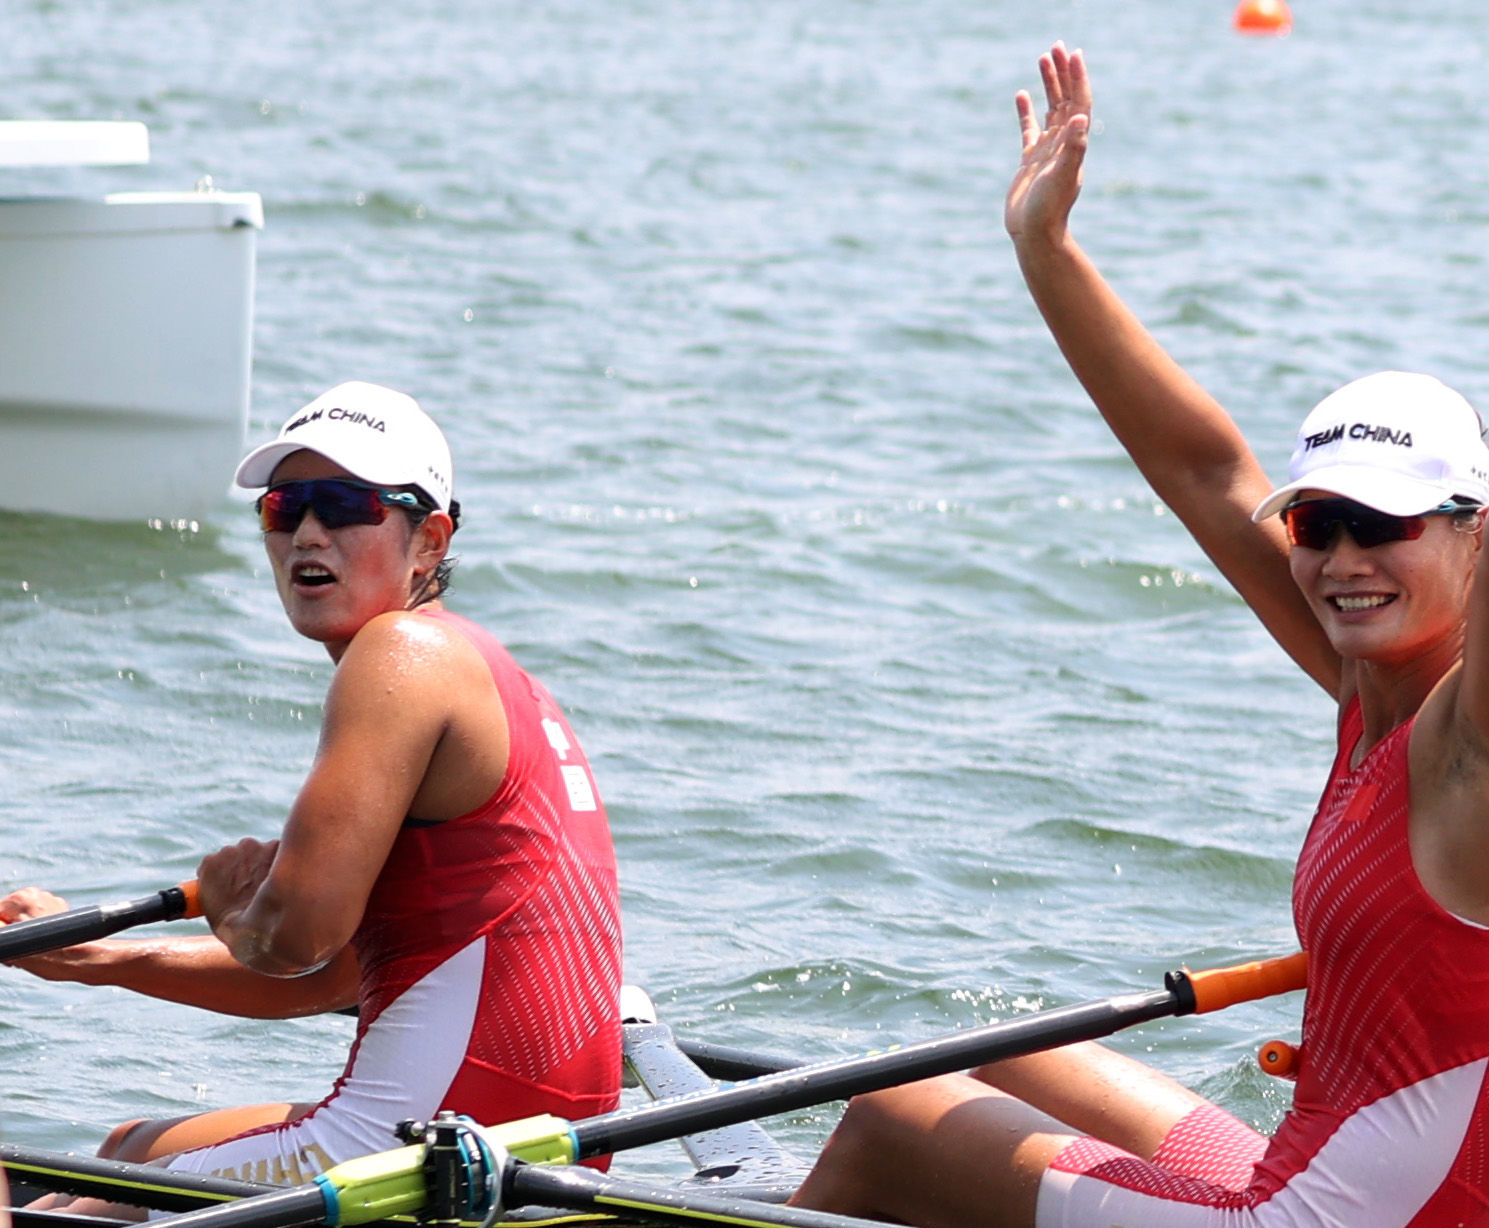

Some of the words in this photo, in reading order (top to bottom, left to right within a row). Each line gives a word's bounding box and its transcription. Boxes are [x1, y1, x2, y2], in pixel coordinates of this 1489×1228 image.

[328, 407, 386, 433] CHINA
[1305, 424, 1346, 452] TEAM
[1349, 423, 1413, 448] CHINA
